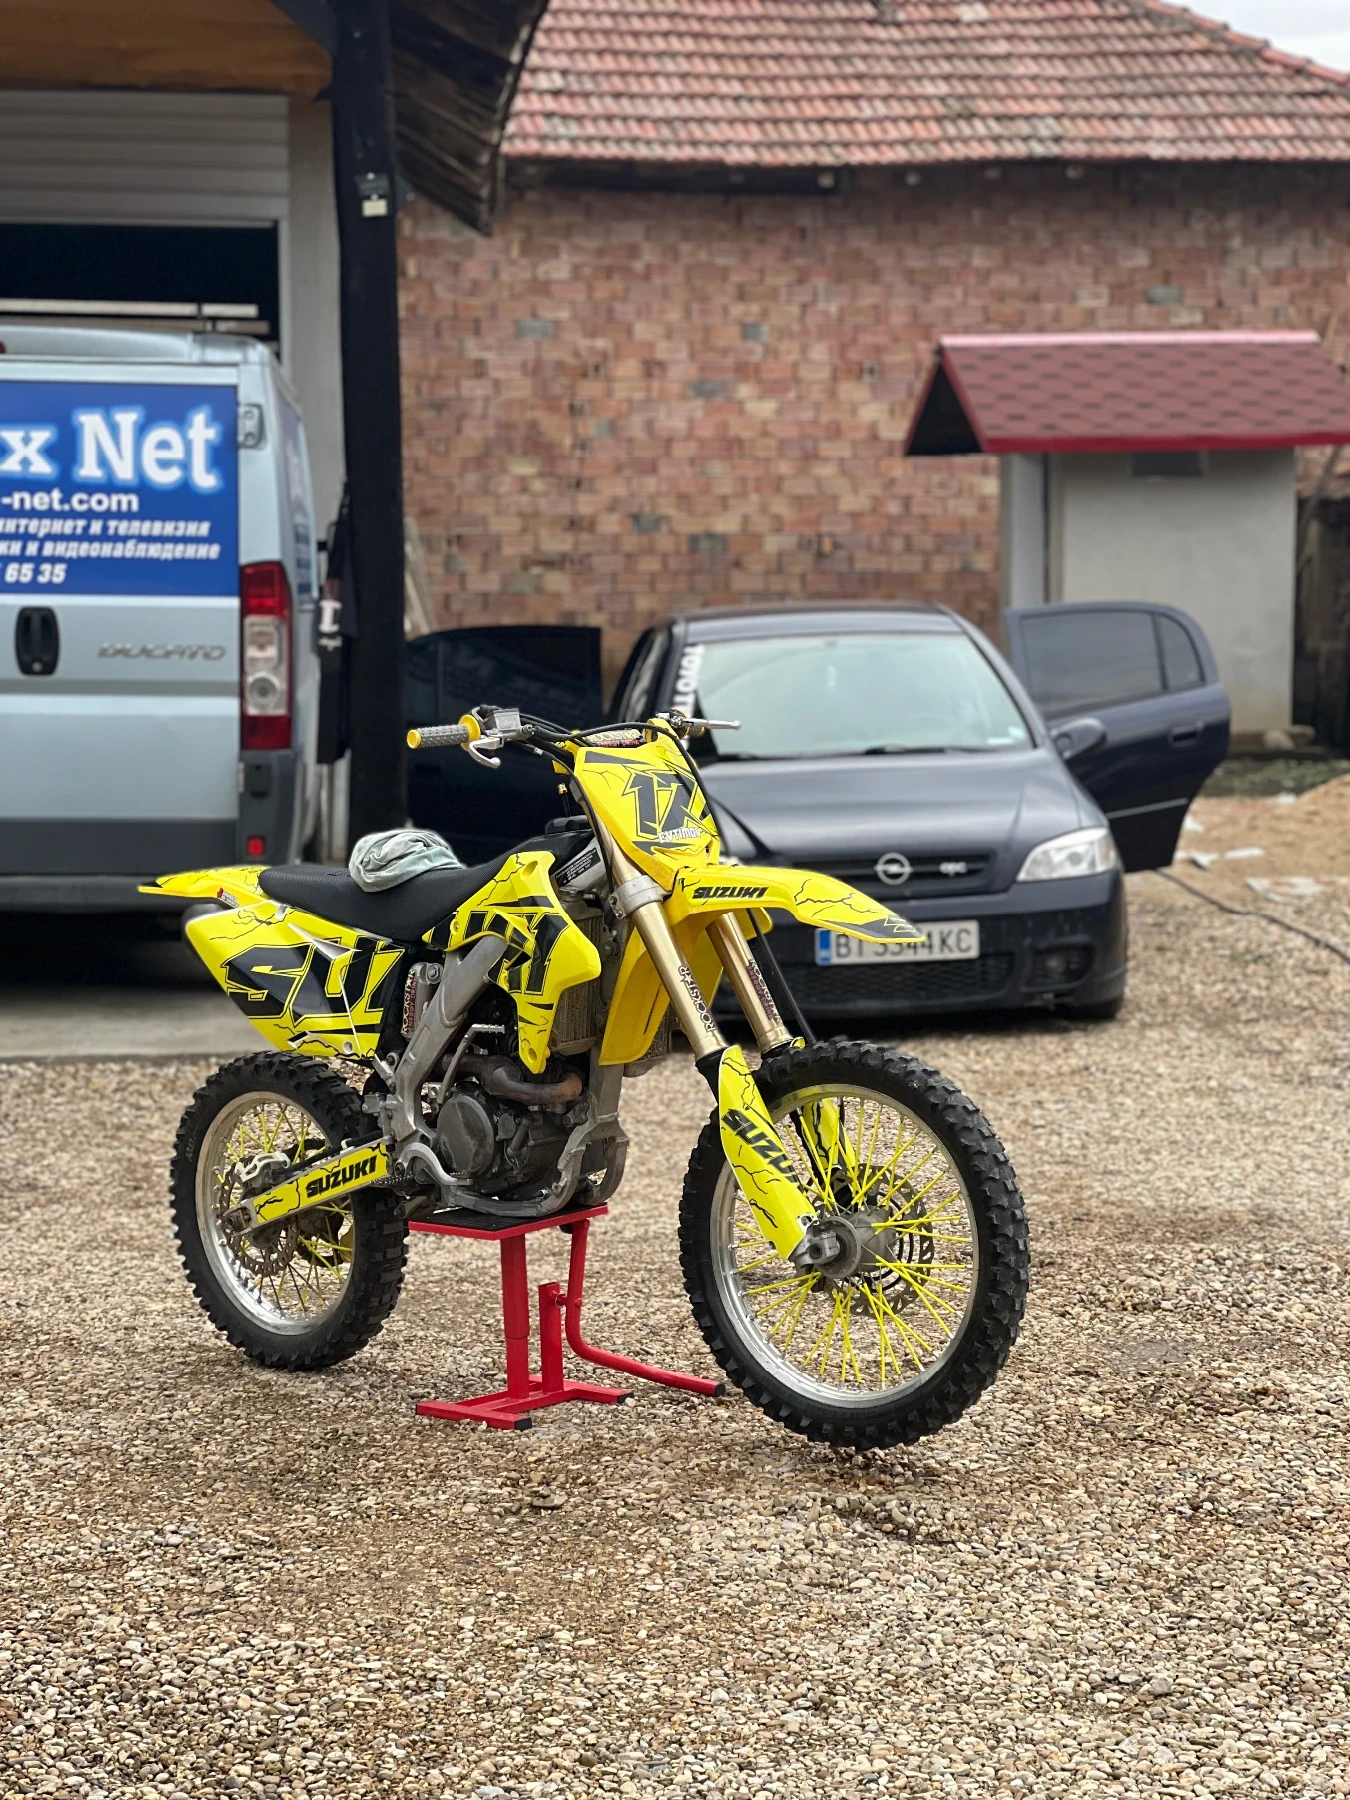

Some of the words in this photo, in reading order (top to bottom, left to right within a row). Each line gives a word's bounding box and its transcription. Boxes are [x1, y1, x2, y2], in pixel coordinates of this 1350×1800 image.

[77, 411, 218, 489] Net
[88, 518, 104, 536] и
[107, 519, 211, 538] телевизия
[25, 540, 40, 557] и
[42, 539, 221, 561] видеонаблюдение
[4, 561, 35, 584] 65
[37, 562, 68, 584] 35
[692, 886, 769, 899] SUZUKI
[305, 1155, 377, 1199] SUZUKI
